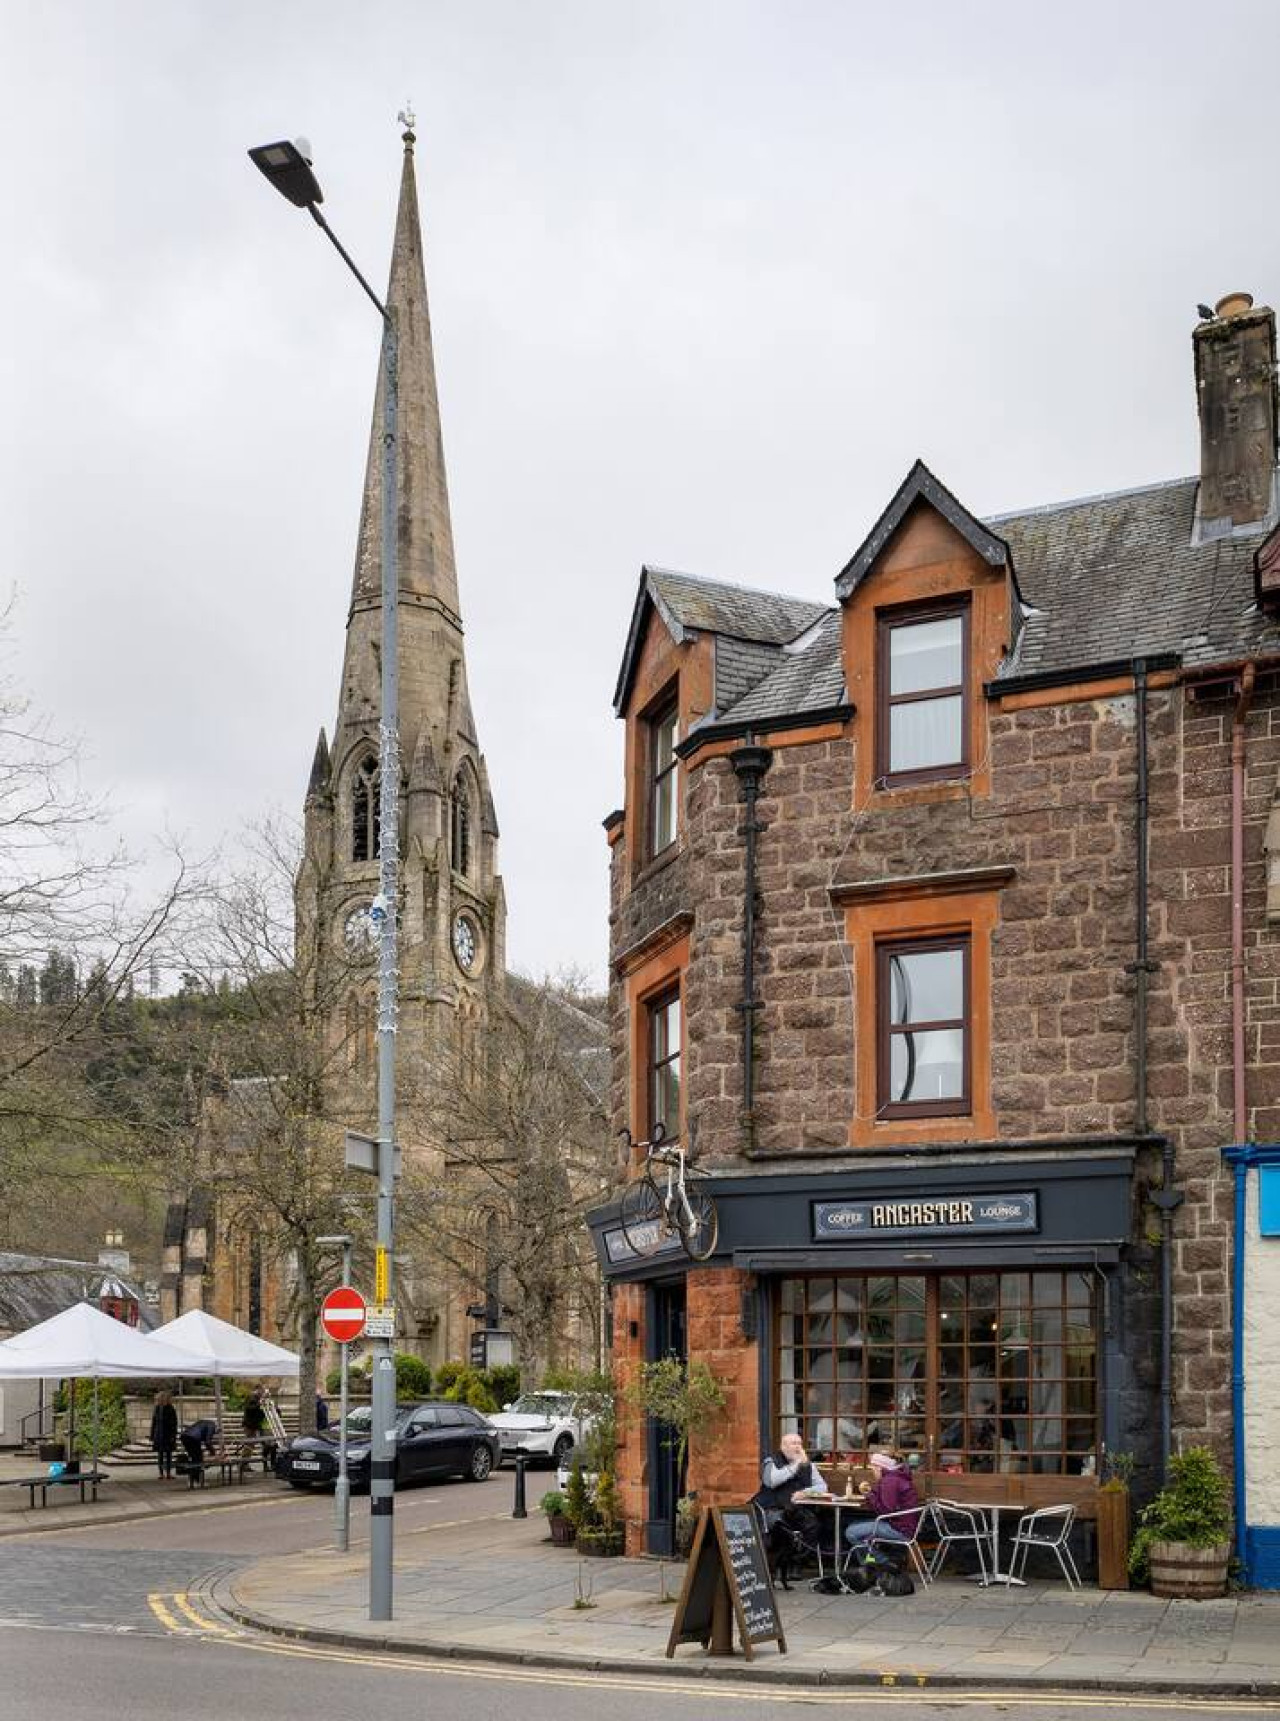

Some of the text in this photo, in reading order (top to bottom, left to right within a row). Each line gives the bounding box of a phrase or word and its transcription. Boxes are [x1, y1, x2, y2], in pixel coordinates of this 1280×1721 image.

[828, 1202, 1022, 1226] COFFEE ANCASTER LOUNGE
